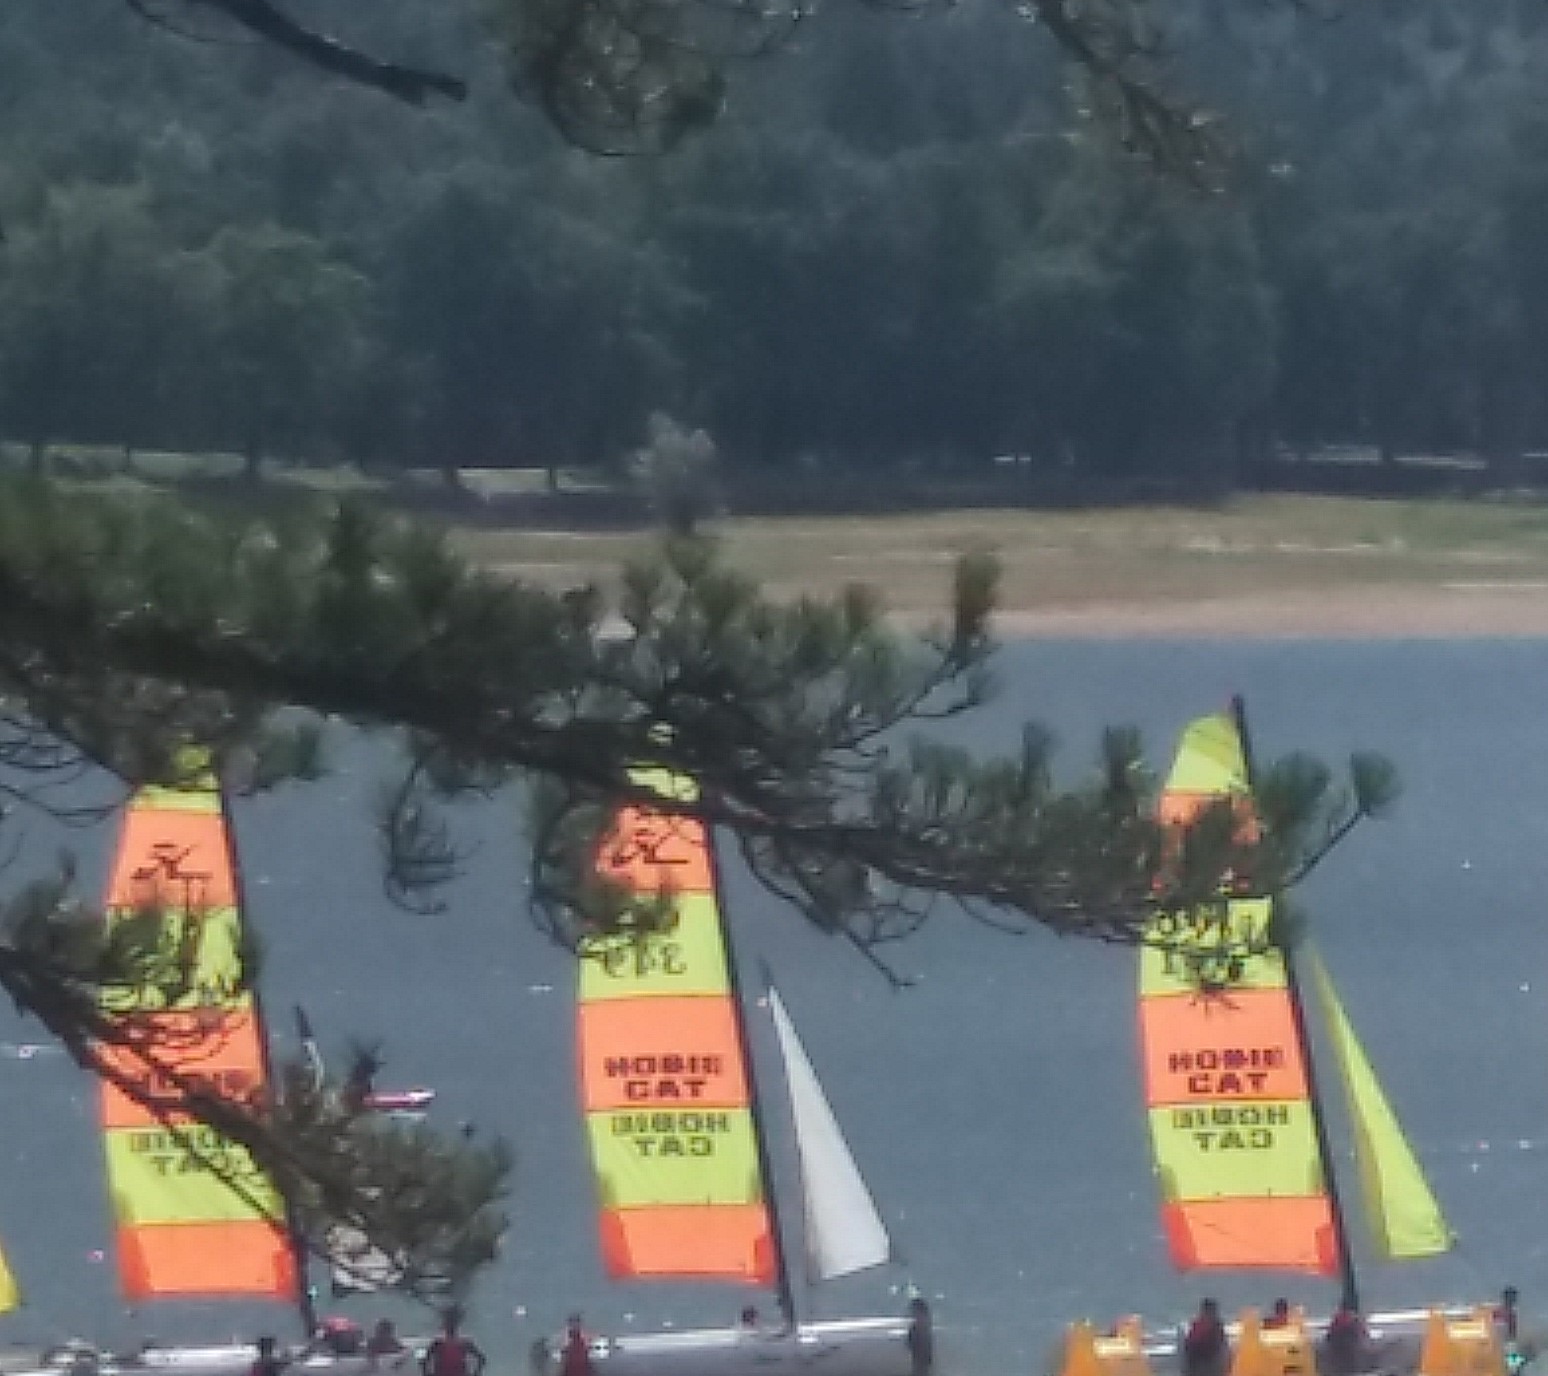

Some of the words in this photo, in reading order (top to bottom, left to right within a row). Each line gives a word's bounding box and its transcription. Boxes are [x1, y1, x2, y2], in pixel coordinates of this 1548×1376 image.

[604, 1055, 721, 1078] HOBIE
[1168, 1048, 1284, 1072] HOBIE
[625, 1080, 705, 1099] CAT
[1189, 1072, 1268, 1094] CAT
